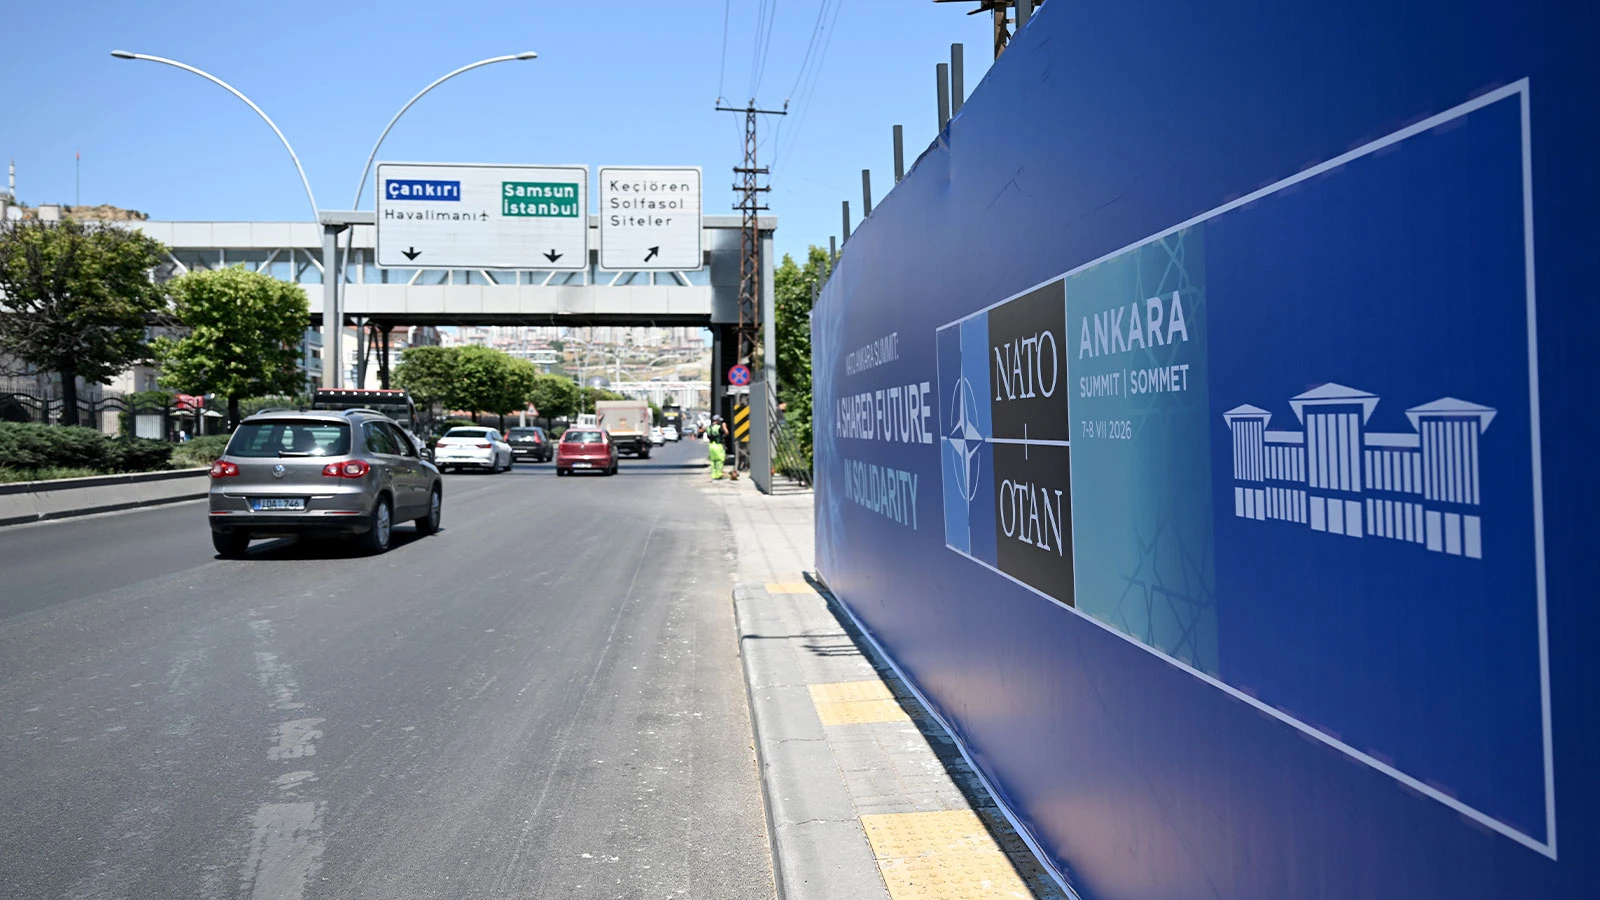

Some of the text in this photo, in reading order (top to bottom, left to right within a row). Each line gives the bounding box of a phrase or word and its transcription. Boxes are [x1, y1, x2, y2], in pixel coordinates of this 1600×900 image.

[388, 182, 458, 199] Çankırı
[504, 183, 575, 198] Samsun
[610, 180, 690, 193] Keçiören
[503, 198, 578, 216] İstanbul
[610, 197, 684, 209] Solfasol
[385, 208, 477, 221] Havalimanı
[610, 214, 672, 226] Siteler
[1079, 290, 1189, 360] ANKARA
[994, 330, 1058, 401] NATO
[1080, 364, 1189, 398] SUMMIT SOMMET
[836, 381, 933, 444] A SHARED FUTURE
[1081, 420, 1132, 440] 7-8 VII 2026
[844, 458, 918, 531] IN SOLIDARITY
[1000, 479, 1063, 557] OTAN
